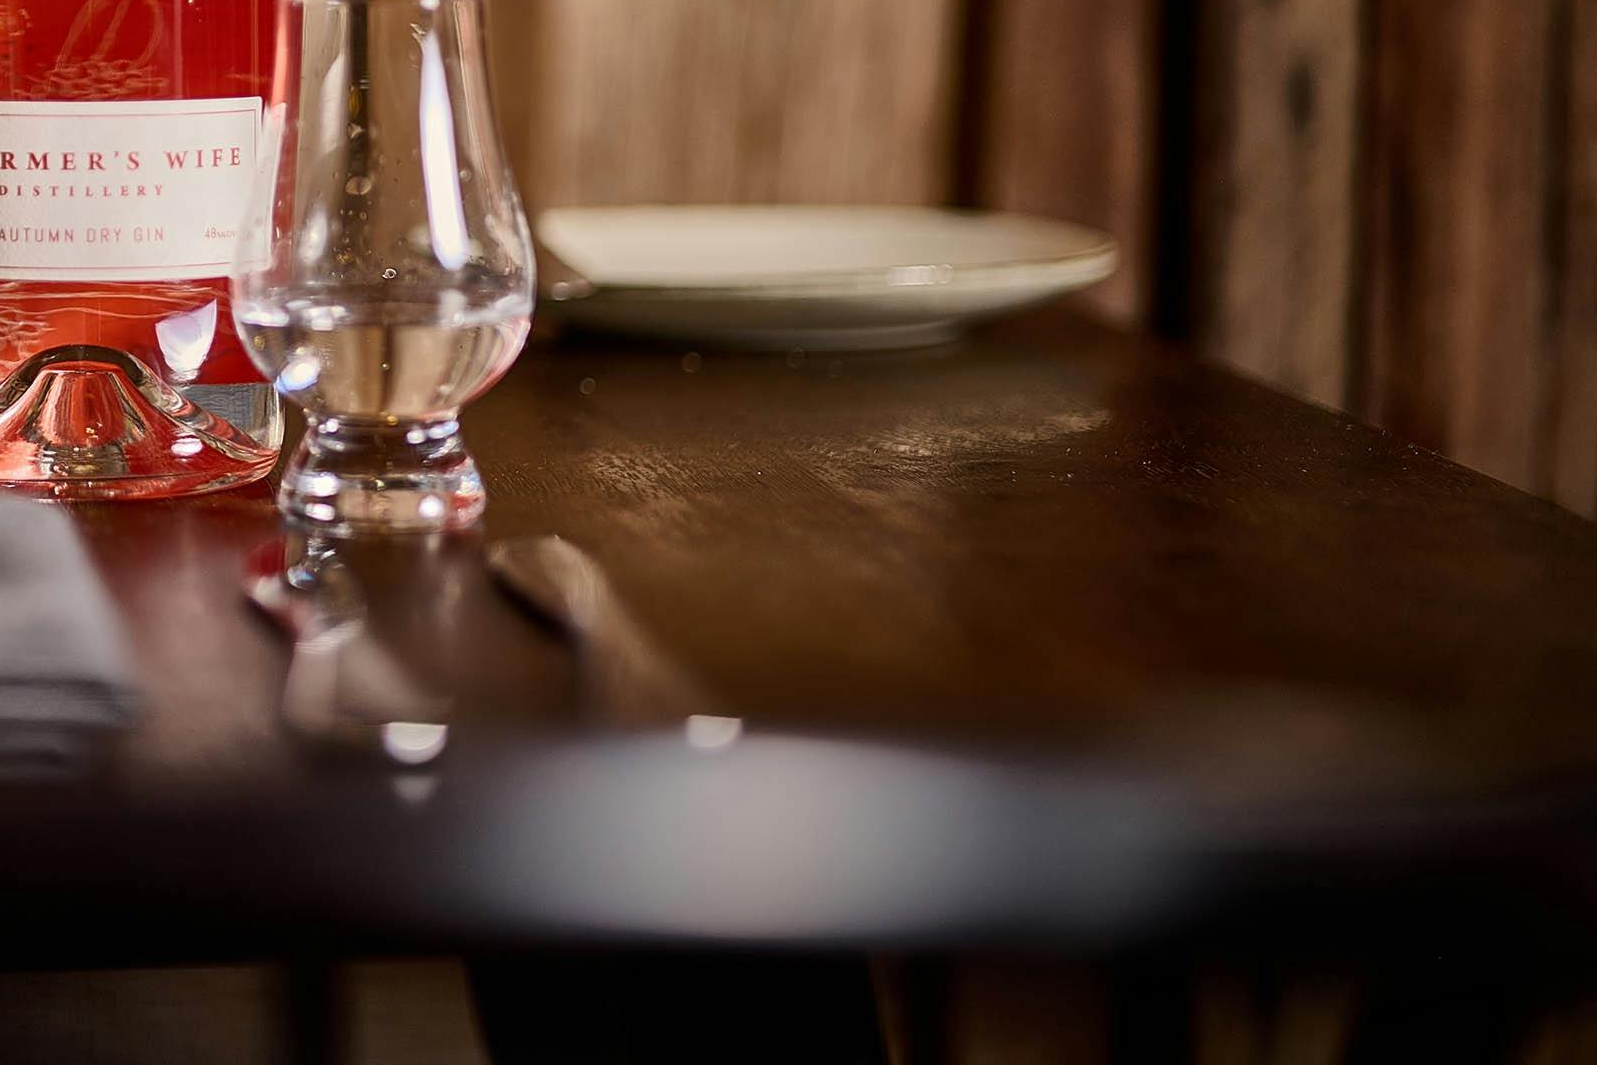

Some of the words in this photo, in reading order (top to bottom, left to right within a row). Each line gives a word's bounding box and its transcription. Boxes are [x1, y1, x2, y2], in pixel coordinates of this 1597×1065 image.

[164, 146, 243, 169] WIFE
[86, 228, 122, 244] DRY
[133, 226, 165, 243] GIN
